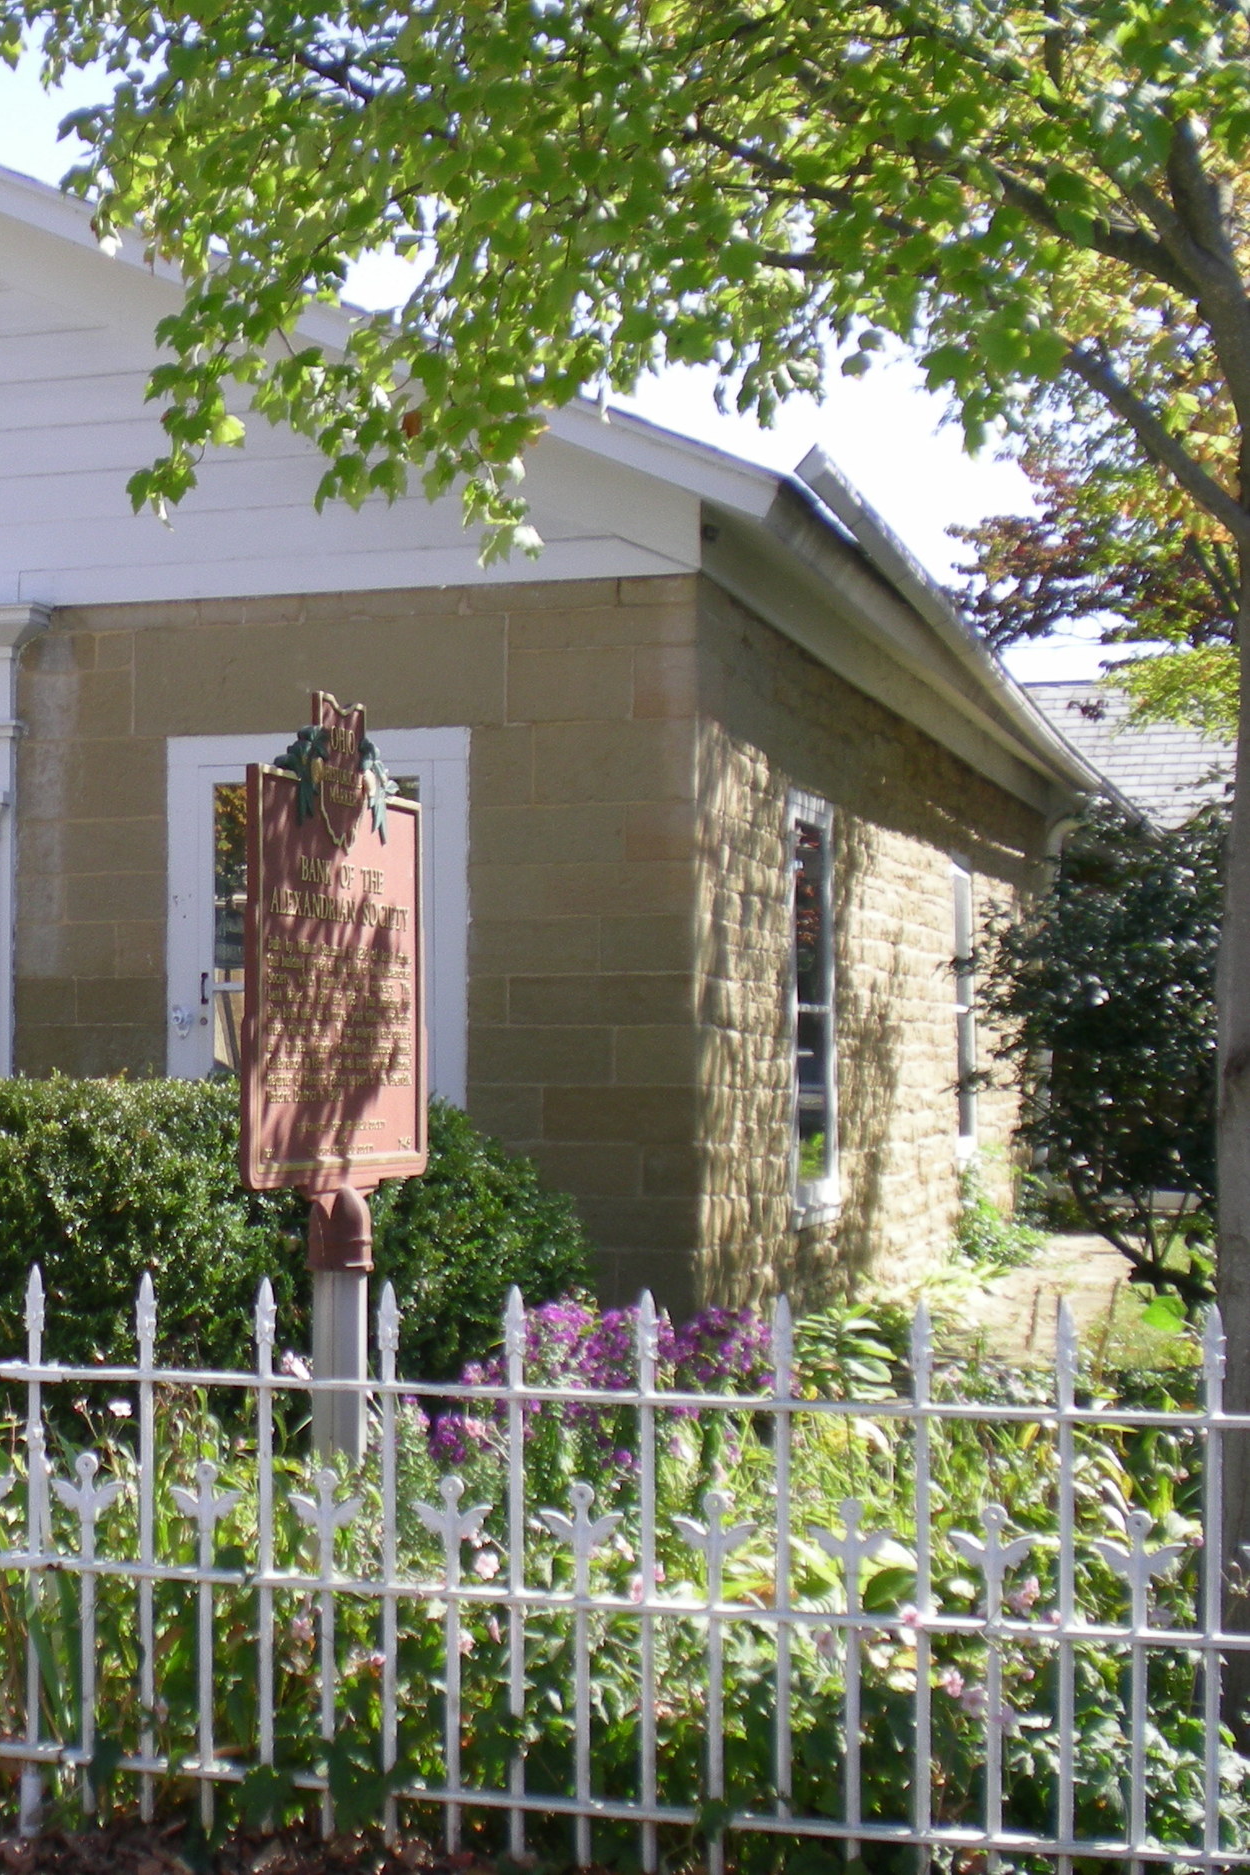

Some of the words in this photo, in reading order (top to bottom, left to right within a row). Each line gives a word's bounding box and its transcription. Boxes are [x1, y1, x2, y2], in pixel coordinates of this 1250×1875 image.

[330, 725, 355, 754] OHIO
[301, 855, 332, 886] BANK
[340, 862, 354, 890] OF
[361, 868, 384, 895] THE
[270, 886, 356, 926] ALEXANDRIAN
[362, 899, 410, 932] SOCIETY
